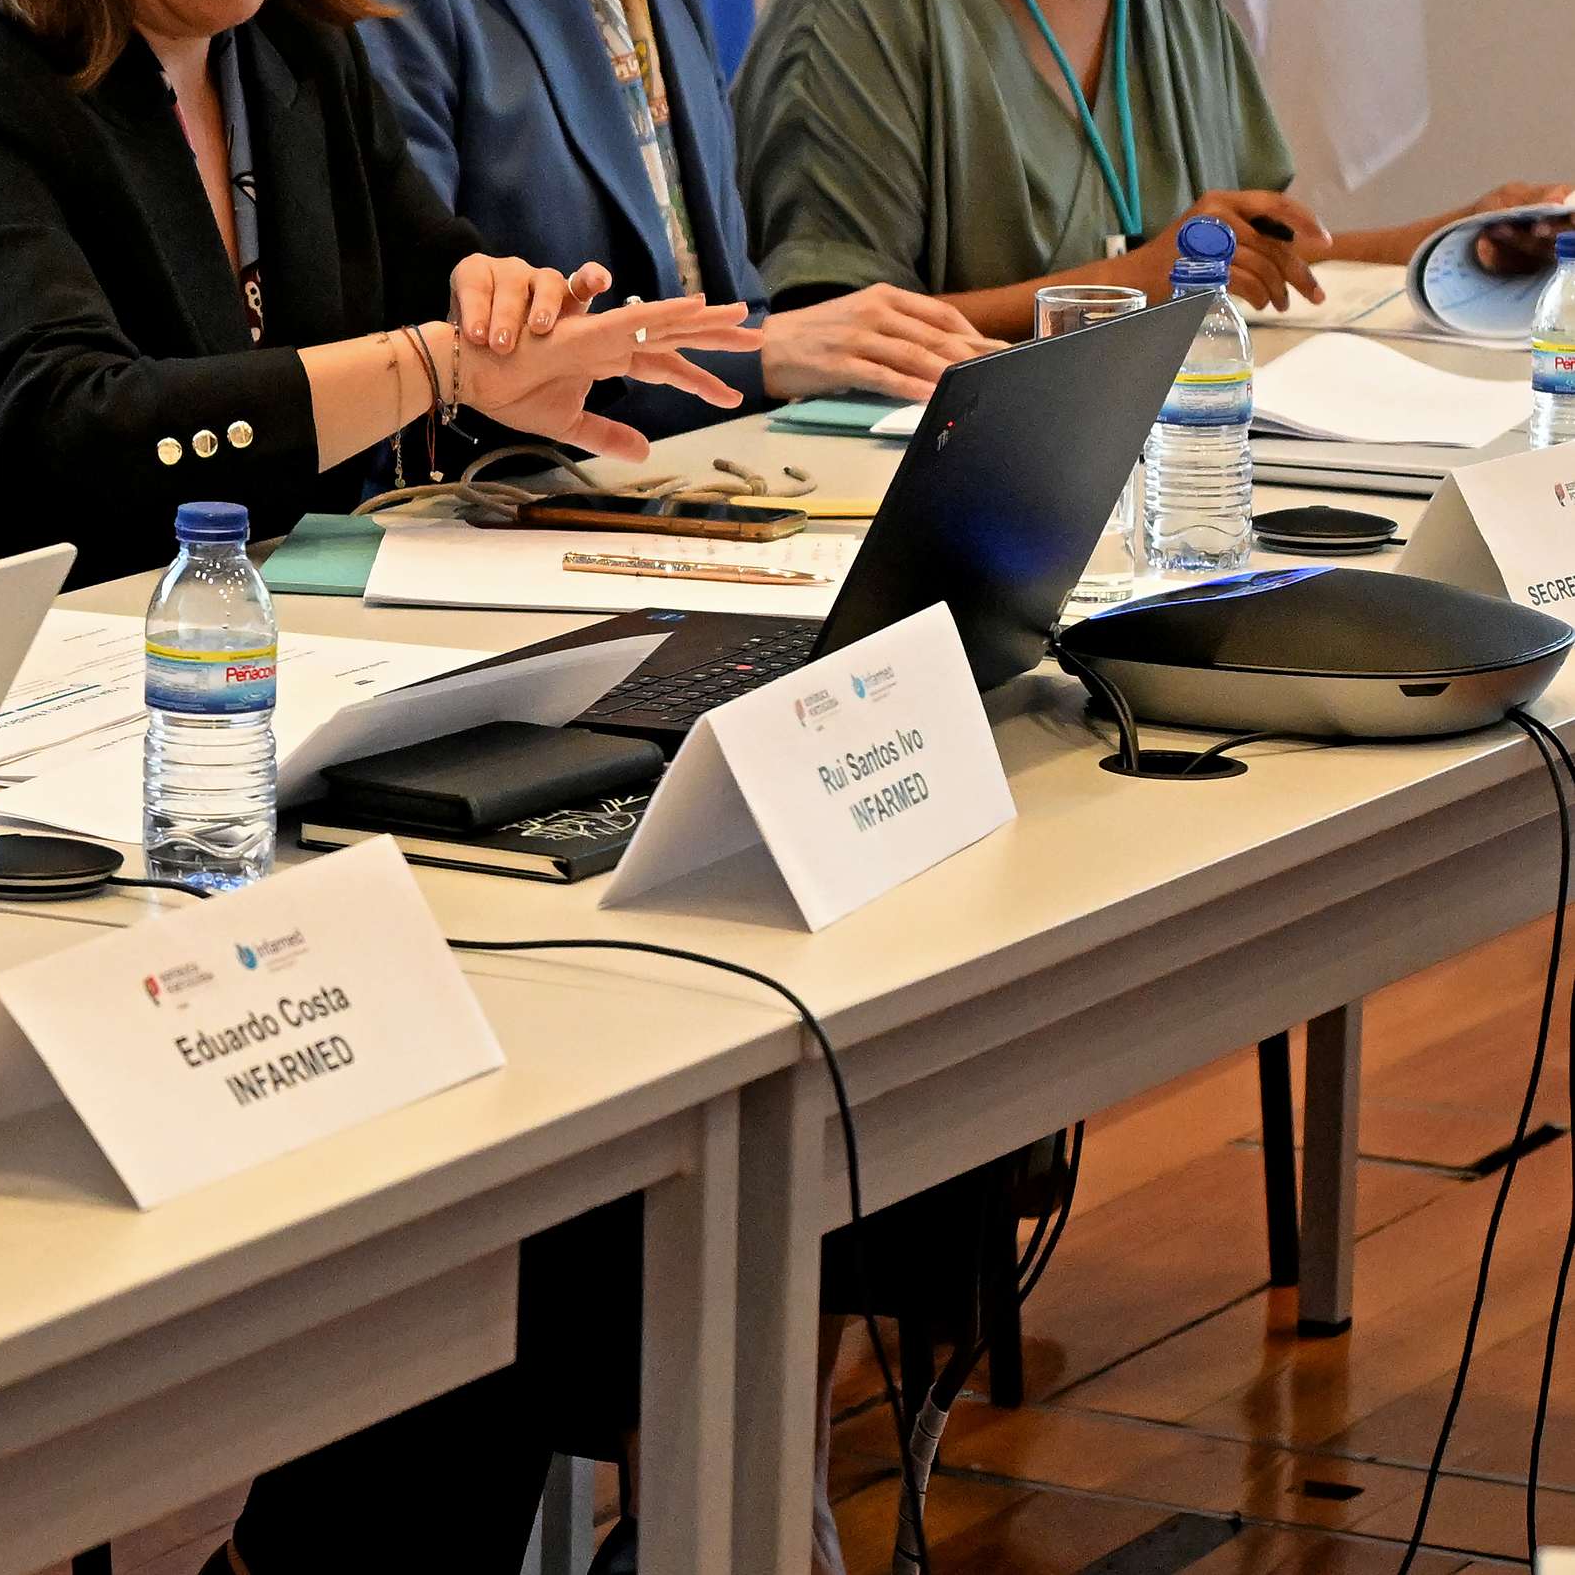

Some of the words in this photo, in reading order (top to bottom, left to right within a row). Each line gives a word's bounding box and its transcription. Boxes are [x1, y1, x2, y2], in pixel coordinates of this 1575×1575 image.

[817, 758, 850, 796] Rui
[845, 741, 901, 782] Santos
[895, 727, 924, 757] Ivo
[849, 771, 930, 833] INFARMED
[174, 1011, 281, 1068] Eduardo
[277, 985, 351, 1029] Costa
[223, 1033, 356, 1107] INFARMED
